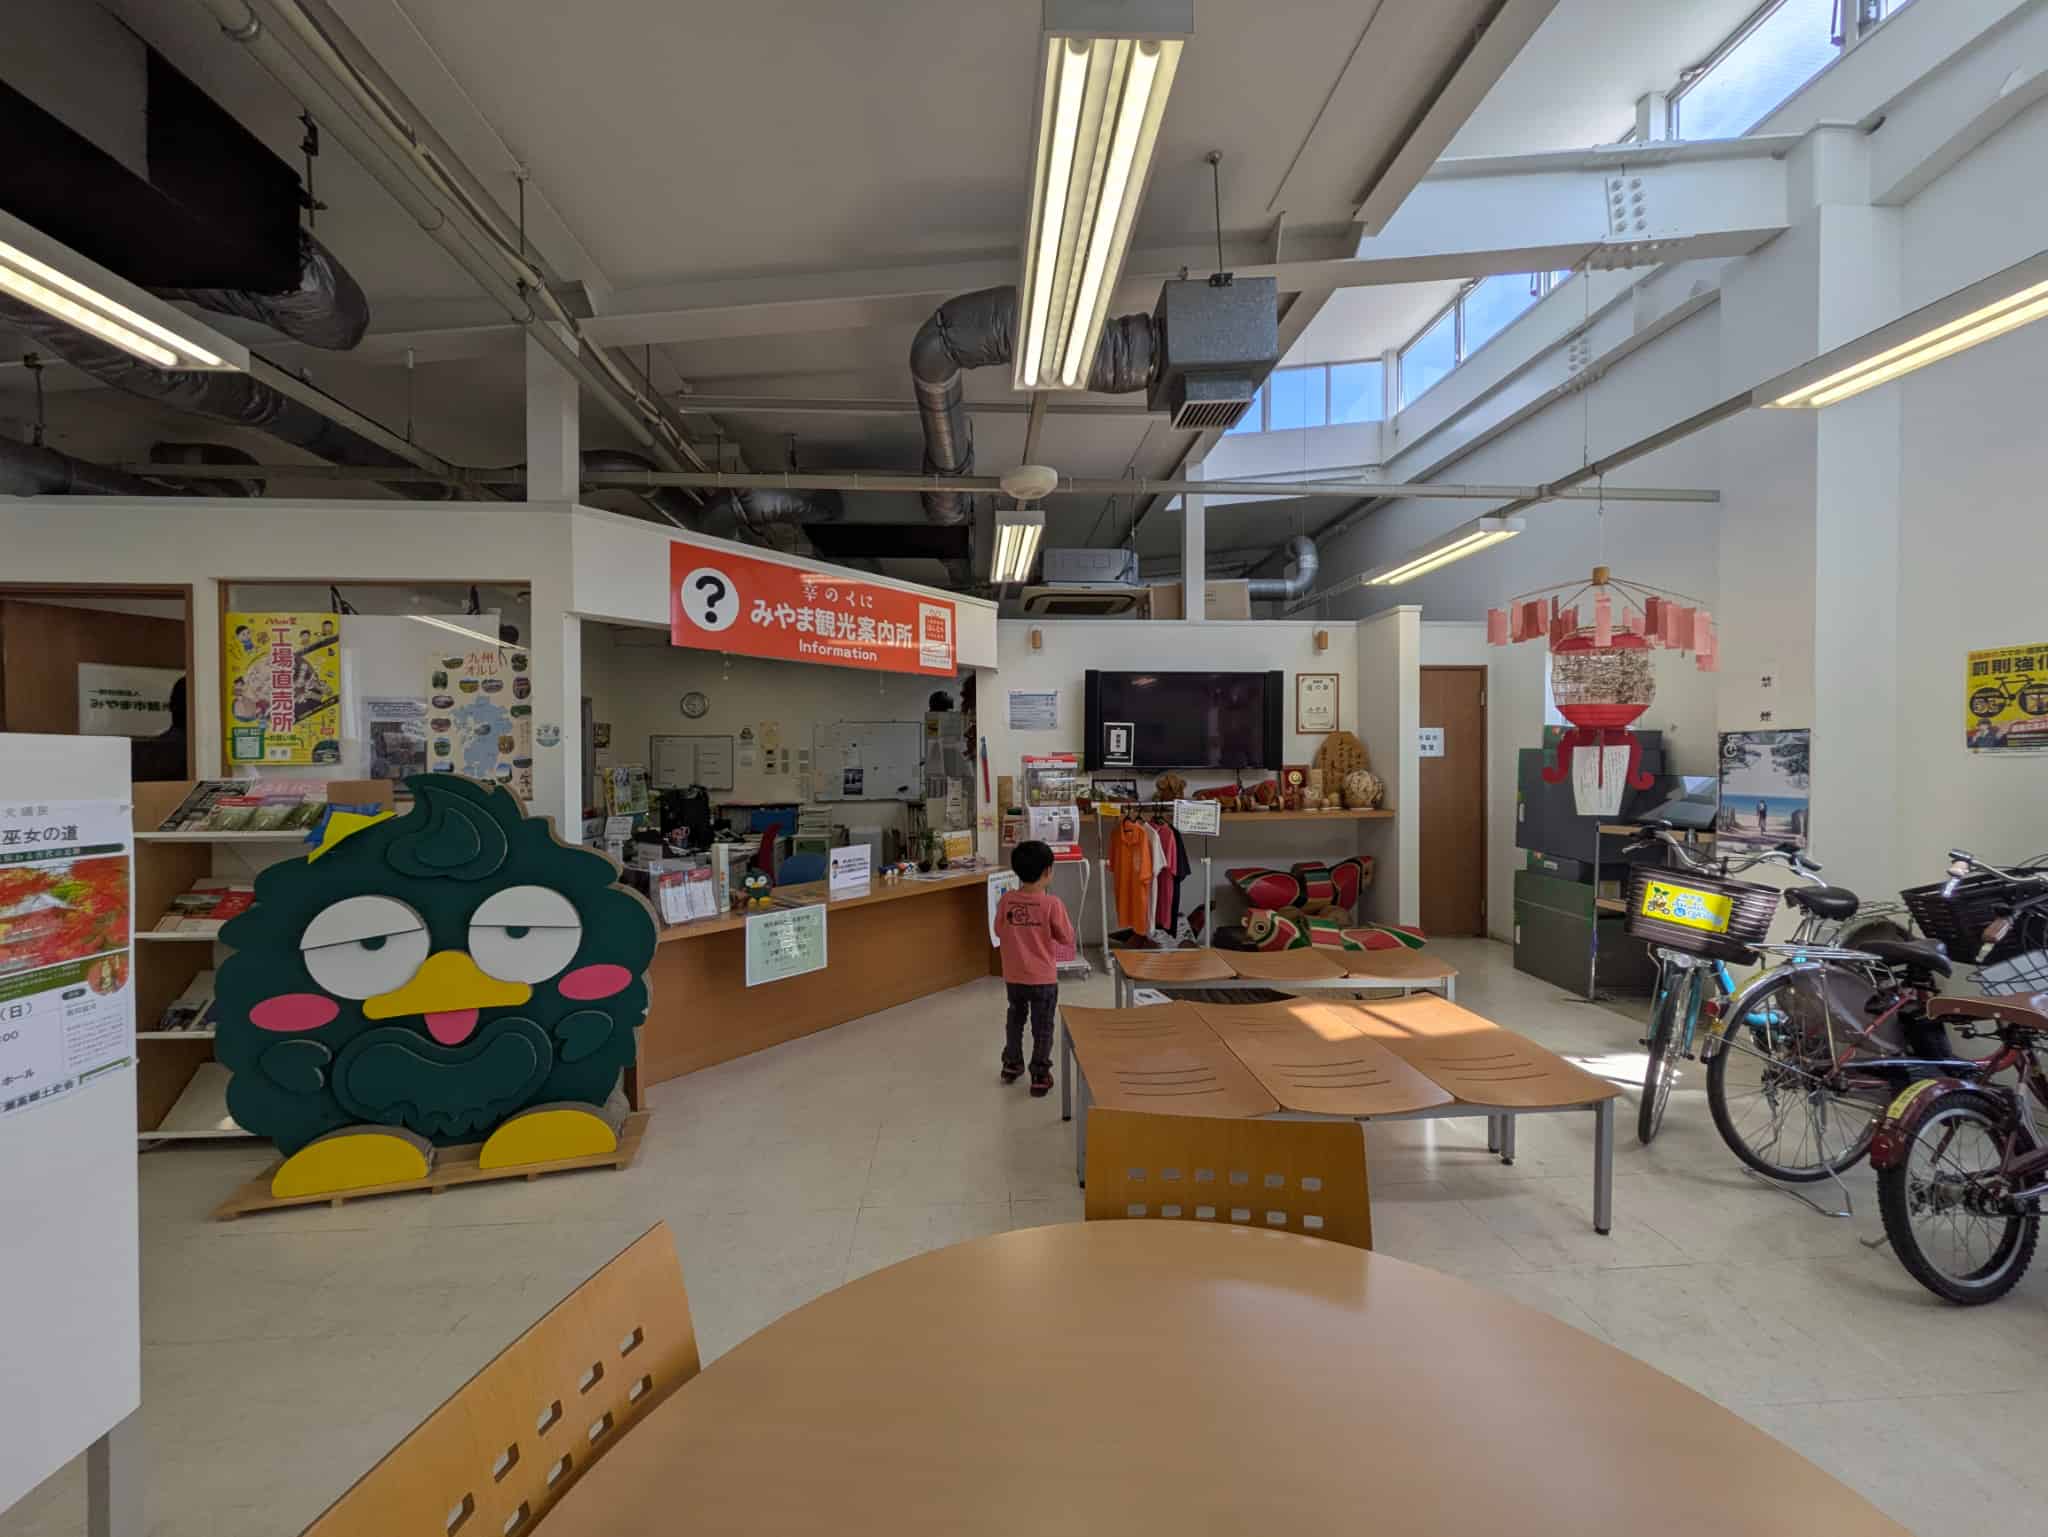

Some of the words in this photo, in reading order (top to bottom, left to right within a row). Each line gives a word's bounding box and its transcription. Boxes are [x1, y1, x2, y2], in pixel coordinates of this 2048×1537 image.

[750, 599, 913, 649] みやま観光案内所
[799, 639, 878, 662] Information
[271, 627, 294, 733] 工場直売所
[1, 825, 79, 845] 巫女の道
